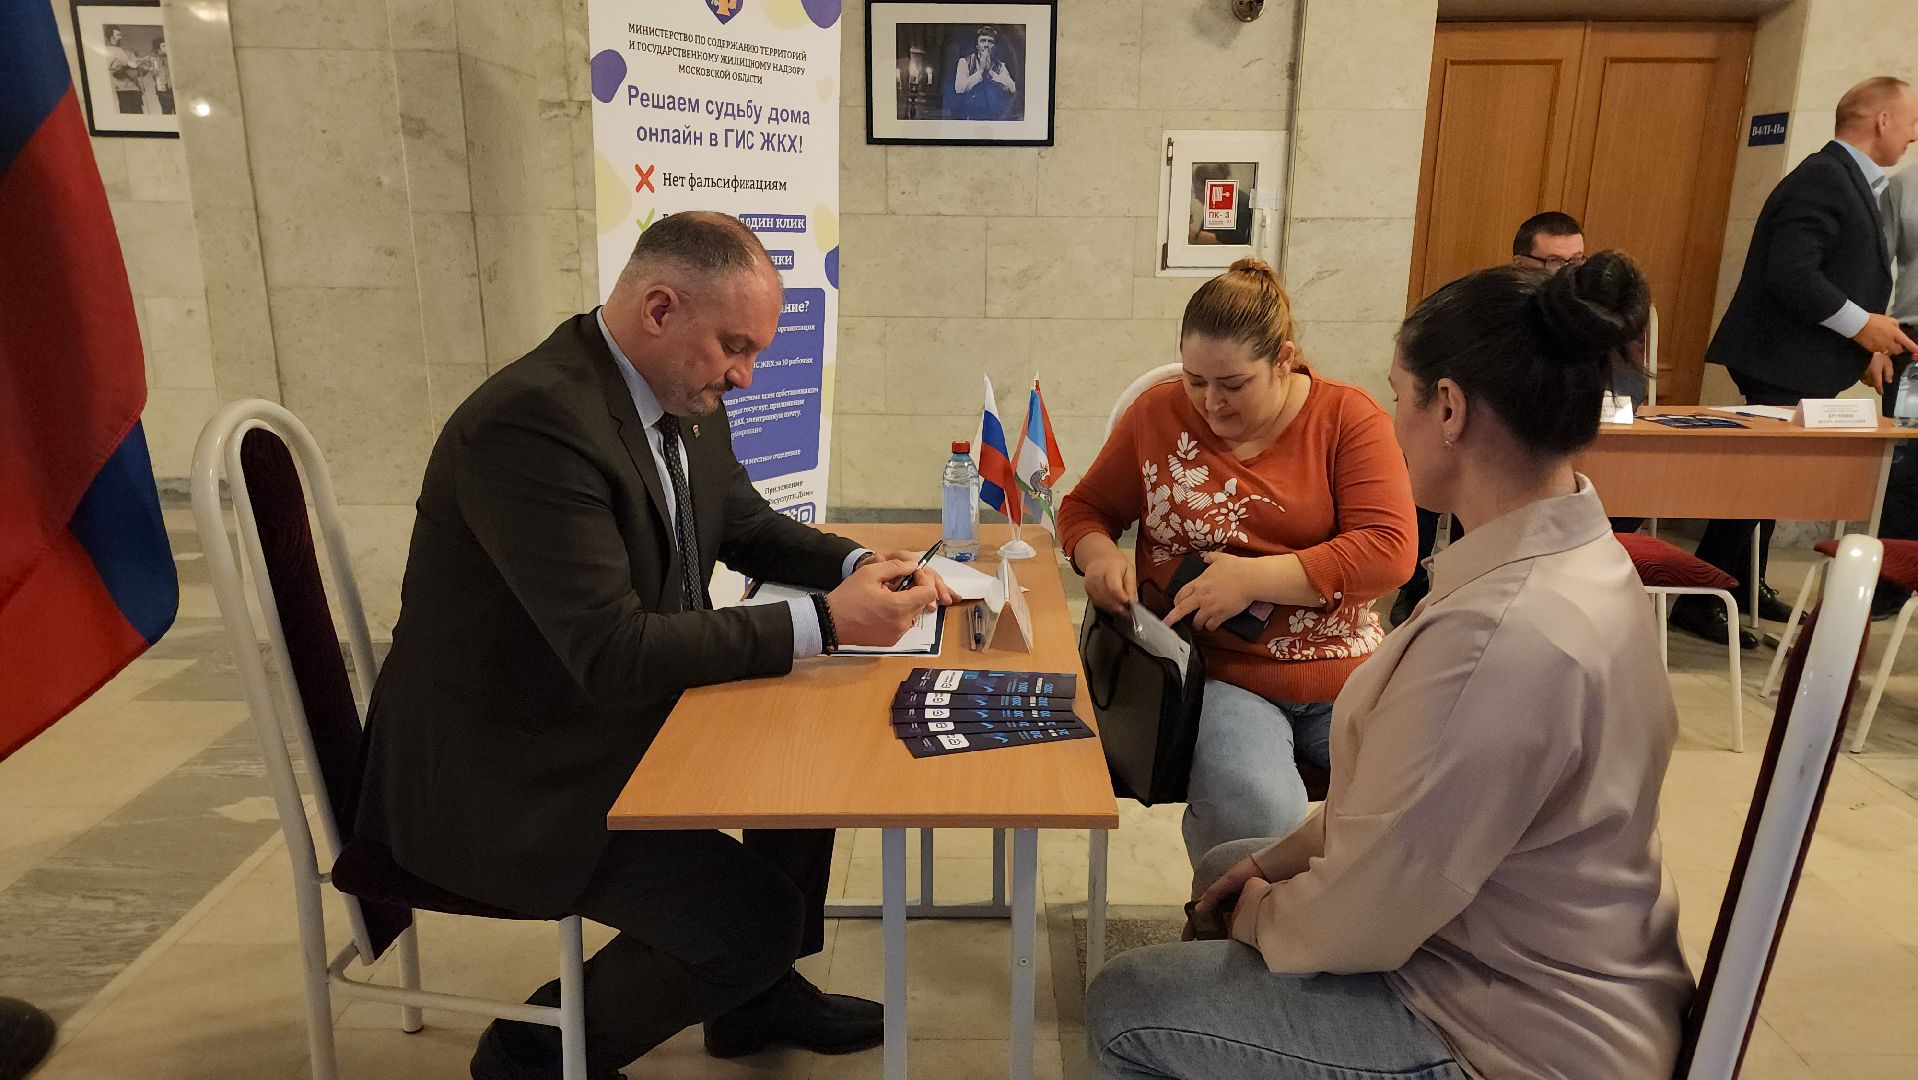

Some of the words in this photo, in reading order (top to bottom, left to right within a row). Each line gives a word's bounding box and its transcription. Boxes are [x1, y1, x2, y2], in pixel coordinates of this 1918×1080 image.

[628, 23, 693, 43] МИНИСТЕРСТВО
[695, 35, 706, 45] ПО
[707, 37, 759, 54] СОДЕРЖАНИЮ
[760, 45, 807, 61] ТЕРРИТОРИЙ
[629, 40, 635, 50] И
[637, 41, 720, 62] ГОСУДАРСТВЕННОМУ
[720, 54, 772, 71] ЖИЛИЩНОМУ
[772, 63, 806, 75] НАДЗОРУ
[679, 65, 731, 80] МОСКОВСКОЙ
[732, 71, 763, 84] ОБЛАСТИ
[627, 85, 700, 114] Решаем
[705, 99, 762, 126] судьбу
[768, 106, 811, 126] дома
[636, 125, 702, 146] онлайн
[709, 132, 719, 147] в
[724, 128, 754, 151] ГИС
[760, 131, 803, 153] ЖКХ!
[662, 172, 686, 188] Нет
[688, 172, 787, 192] фальсификациям
[775, 218, 806, 229] клик
[770, 255, 793, 266] чки
[781, 300, 810, 313] ние?
